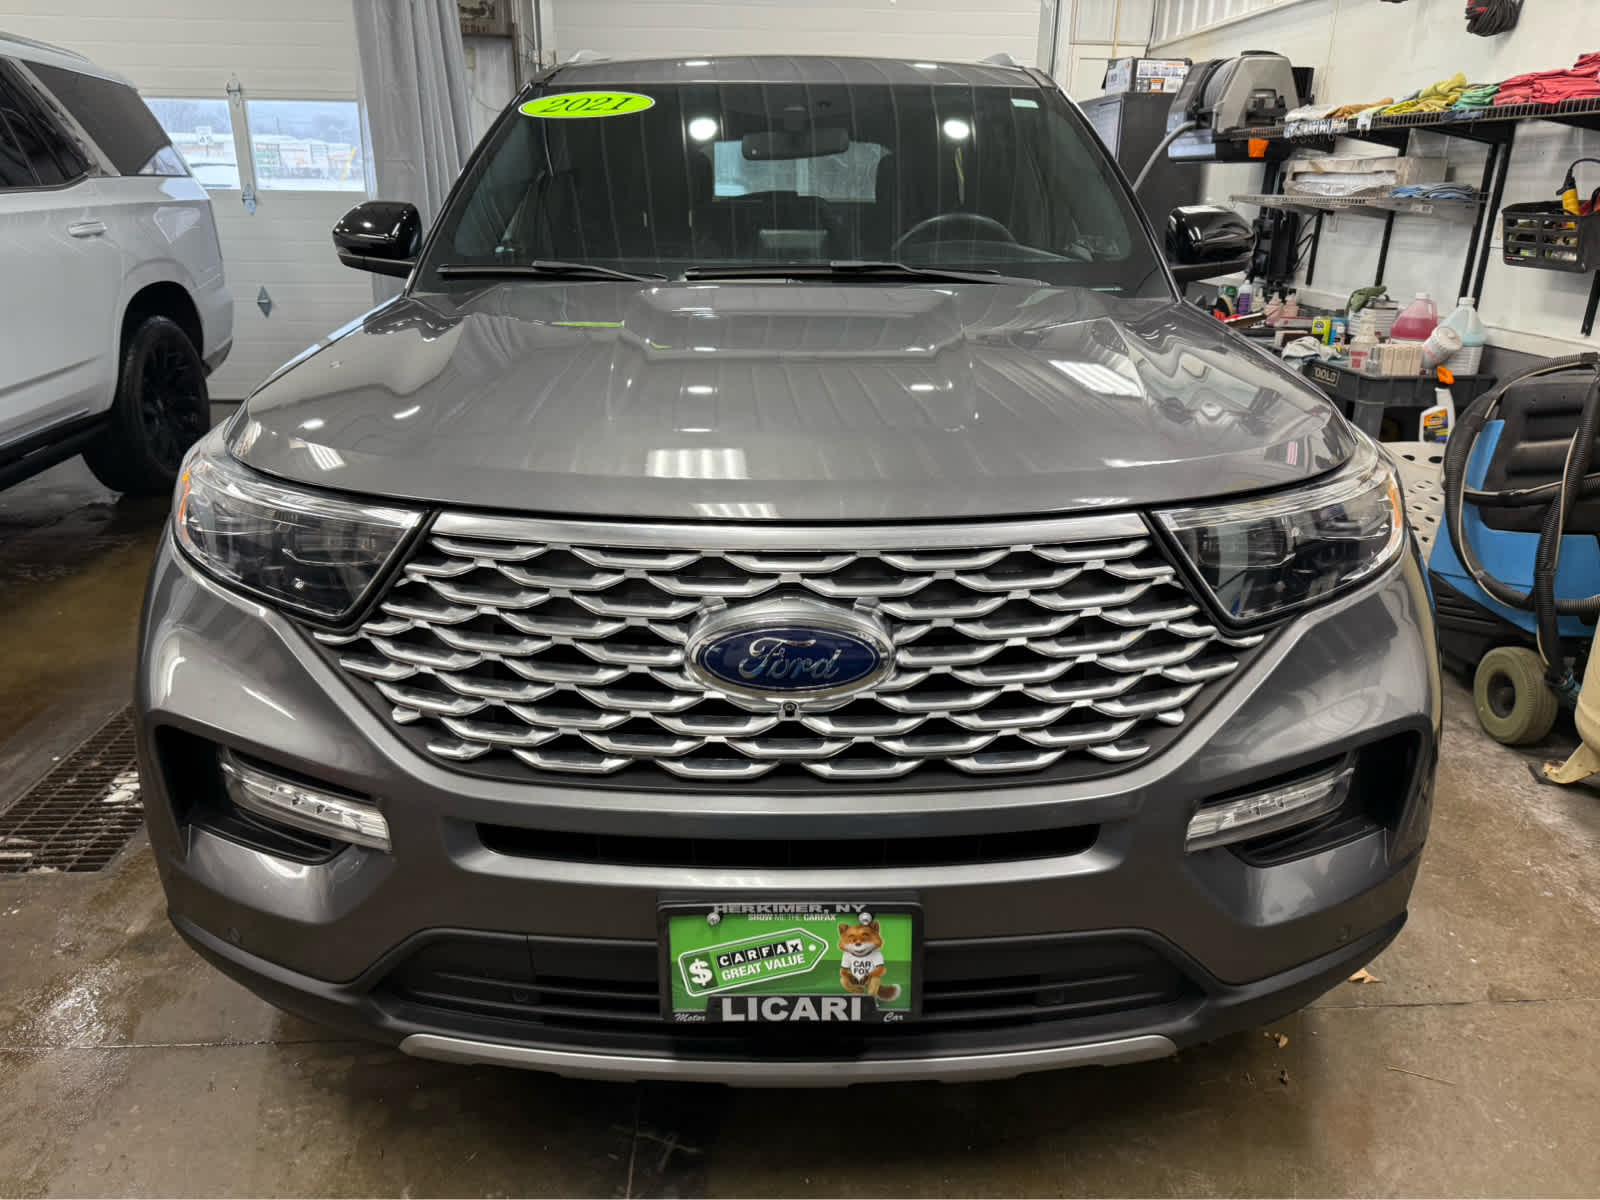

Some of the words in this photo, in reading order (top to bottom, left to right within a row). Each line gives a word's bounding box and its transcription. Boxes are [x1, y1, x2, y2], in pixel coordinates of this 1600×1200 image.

[538, 97, 633, 113] 2021
[738, 636, 842, 680] Ford
[713, 904, 830, 914] HERKIMER,
[836, 904, 868, 913] NY
[803, 913, 837, 921] CARFAX
[717, 941, 803, 968] CARFAX
[722, 964, 762, 981] GREAT
[765, 954, 806, 971] VALUE
[721, 997, 862, 1022] LICARI
